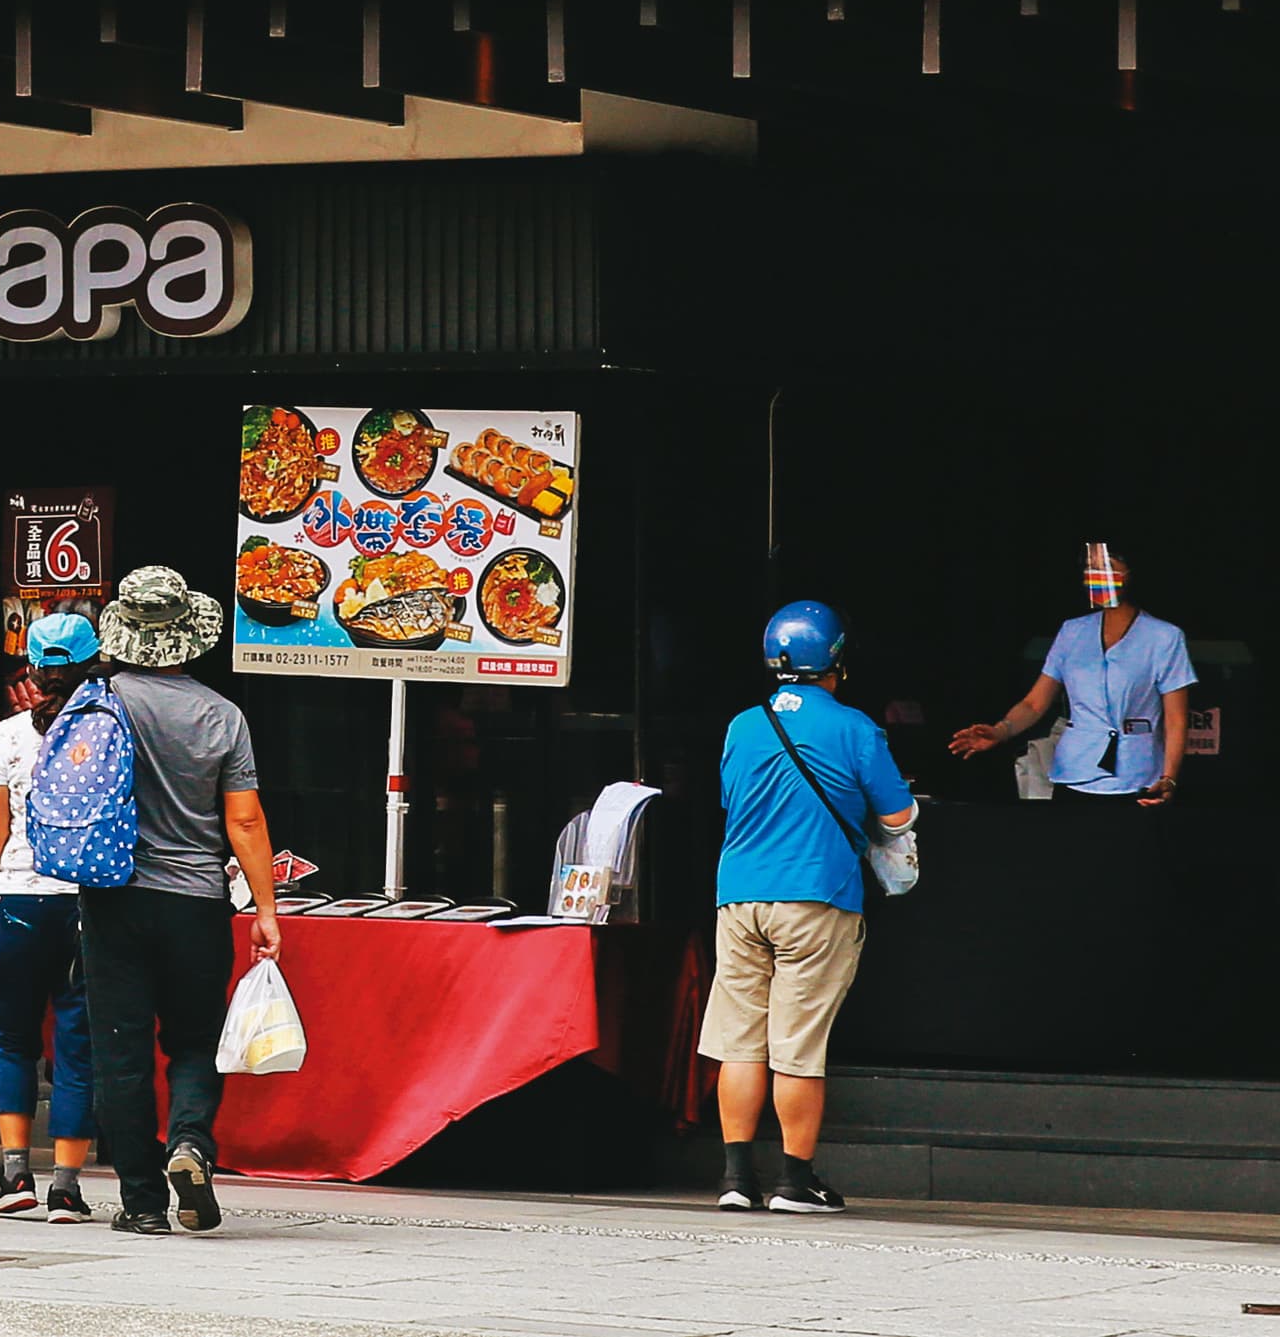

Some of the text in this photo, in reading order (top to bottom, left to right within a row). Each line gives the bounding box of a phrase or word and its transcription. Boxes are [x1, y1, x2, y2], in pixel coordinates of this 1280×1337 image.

[320, 432, 337, 451] 推
[27, 525, 42, 578] 全品項
[453, 572, 470, 590] 推
[275, 652, 349, 666] 02-2311-1577
